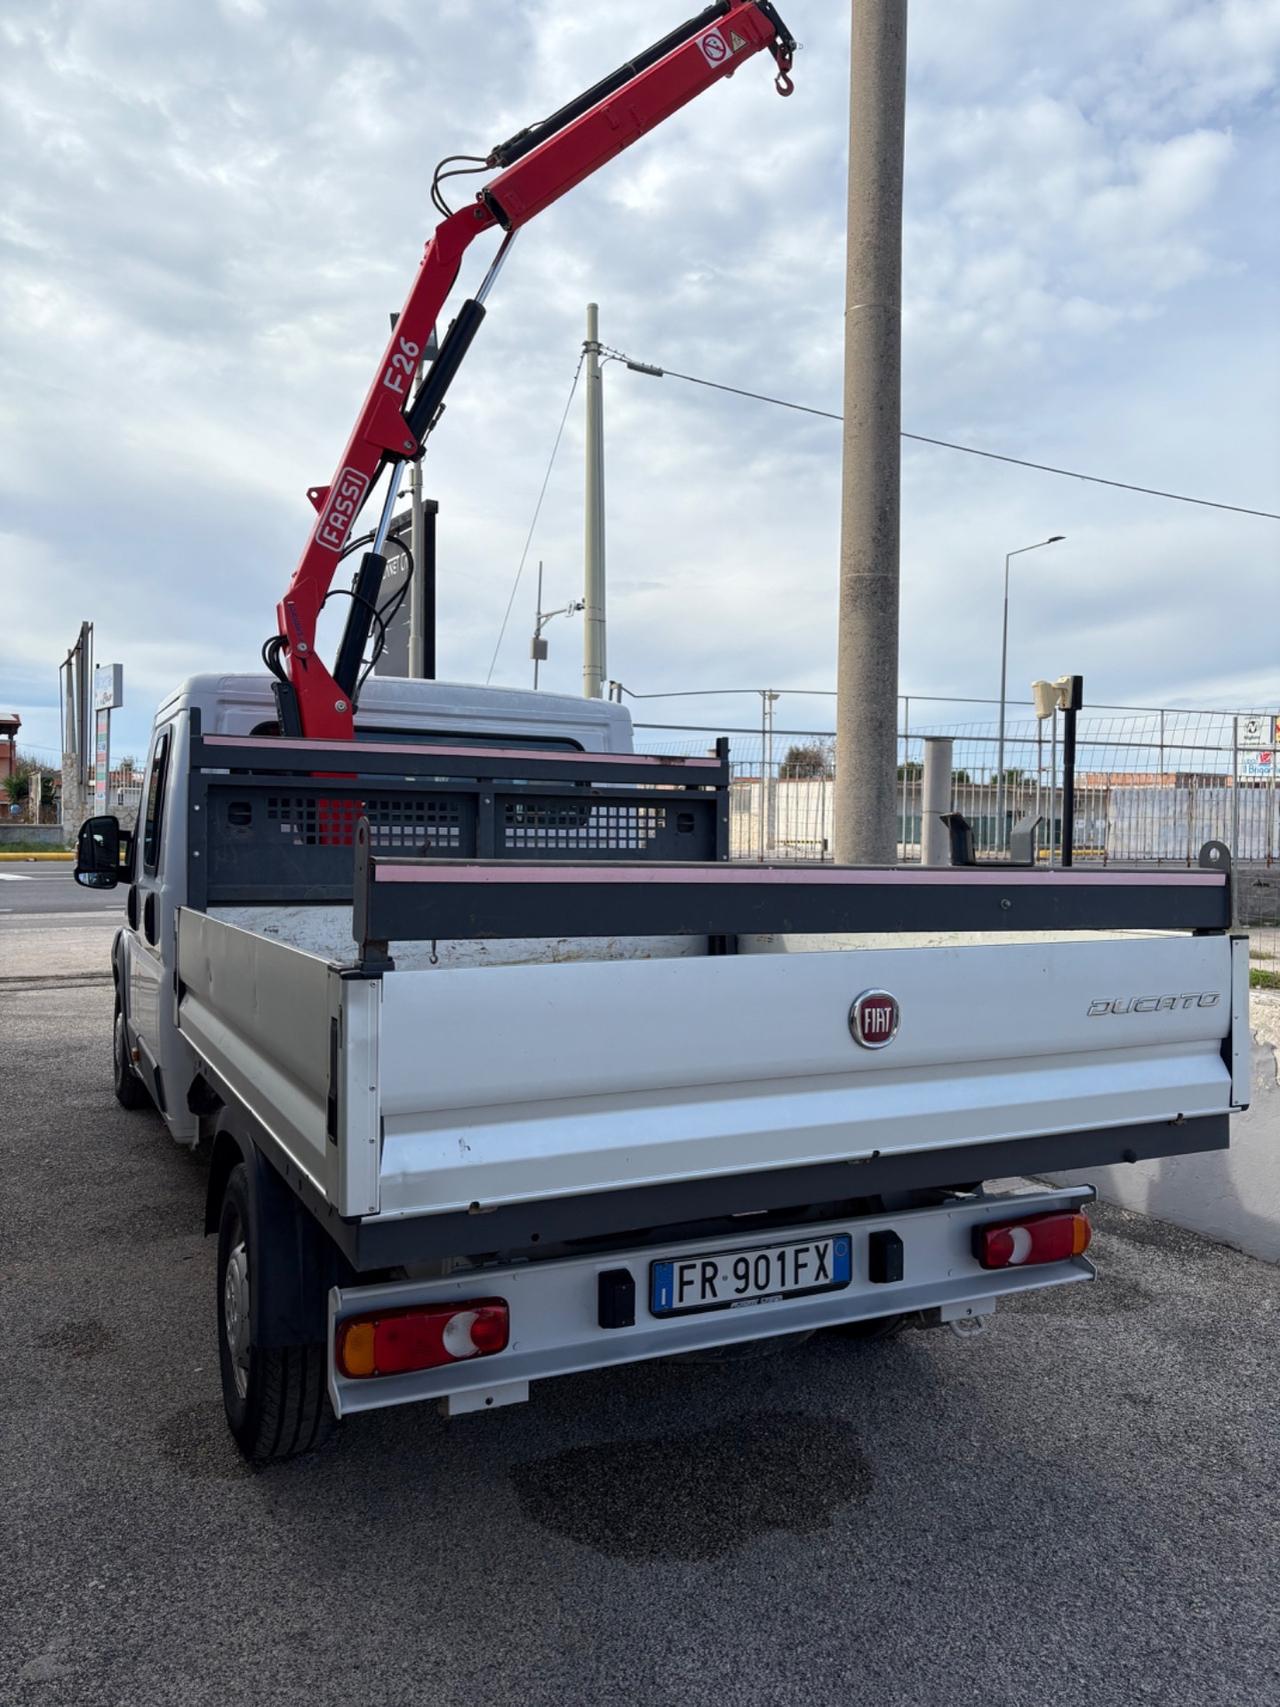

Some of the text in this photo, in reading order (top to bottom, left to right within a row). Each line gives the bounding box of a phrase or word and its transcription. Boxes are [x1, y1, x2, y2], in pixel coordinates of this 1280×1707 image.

[383, 336, 419, 394] F26
[322, 474, 364, 544] FASSI
[864, 1006, 893, 1035] FIAT
[1087, 991, 1222, 1017] DUCATO
